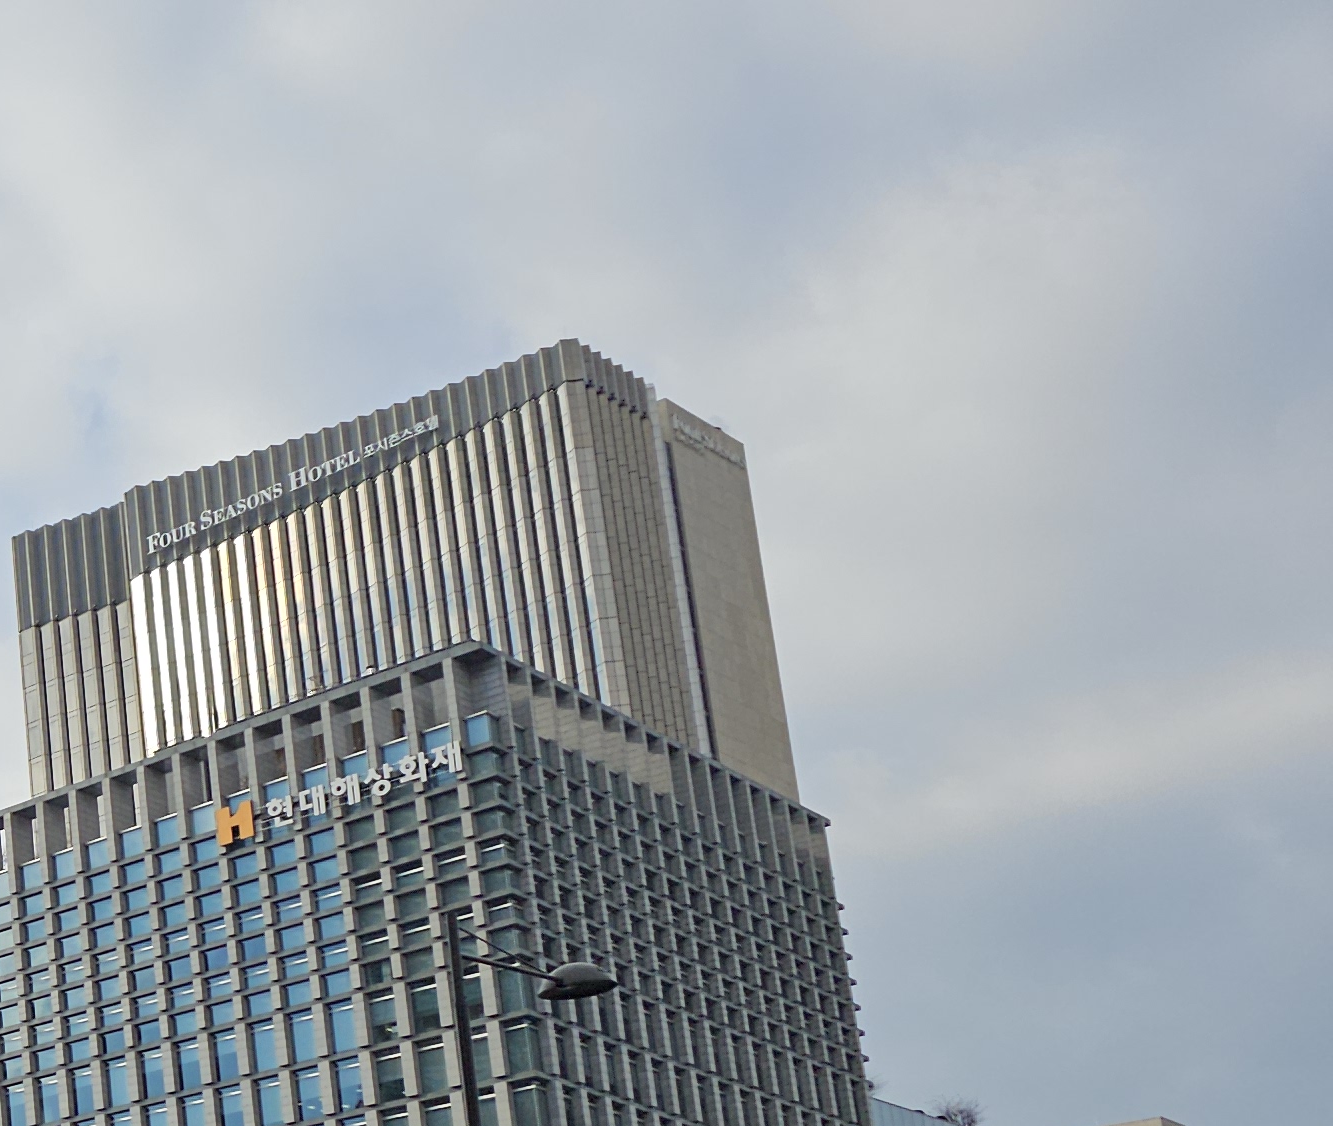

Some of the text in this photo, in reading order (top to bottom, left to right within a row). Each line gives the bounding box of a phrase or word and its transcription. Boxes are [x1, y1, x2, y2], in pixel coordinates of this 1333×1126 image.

[146, 521, 196, 555] FOUR
[199, 483, 283, 530] SEASONS
[288, 450, 360, 492] HOTEL
[266, 741, 463, 827] 현대해상화재
